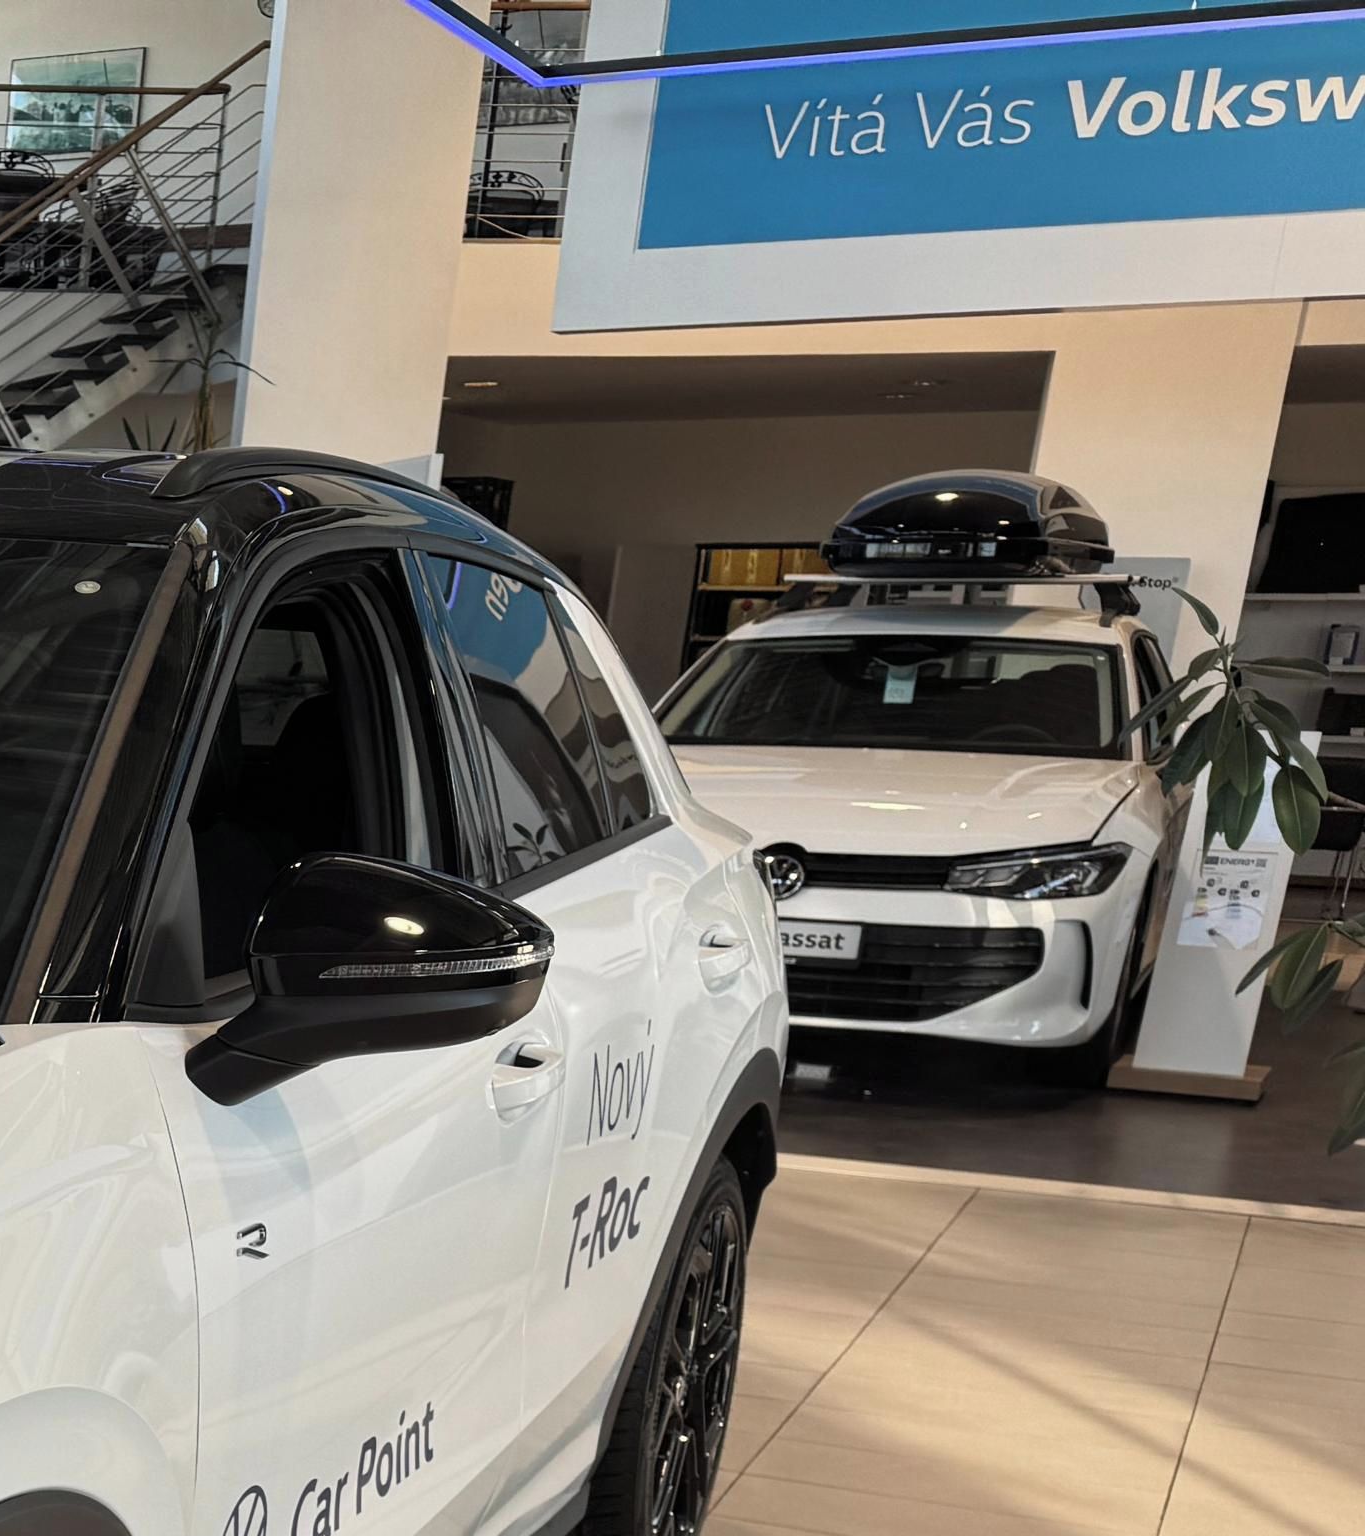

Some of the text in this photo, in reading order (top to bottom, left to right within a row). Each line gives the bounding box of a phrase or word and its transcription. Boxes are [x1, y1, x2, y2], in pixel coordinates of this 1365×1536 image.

[764, 93, 887, 160] Vítá
[915, 84, 1035, 149] Vás
[780, 932, 846, 951] assat
[586, 1019, 655, 1146] Nový
[564, 1175, 651, 1291] T-Roc
[355, 1400, 436, 1516] Point
